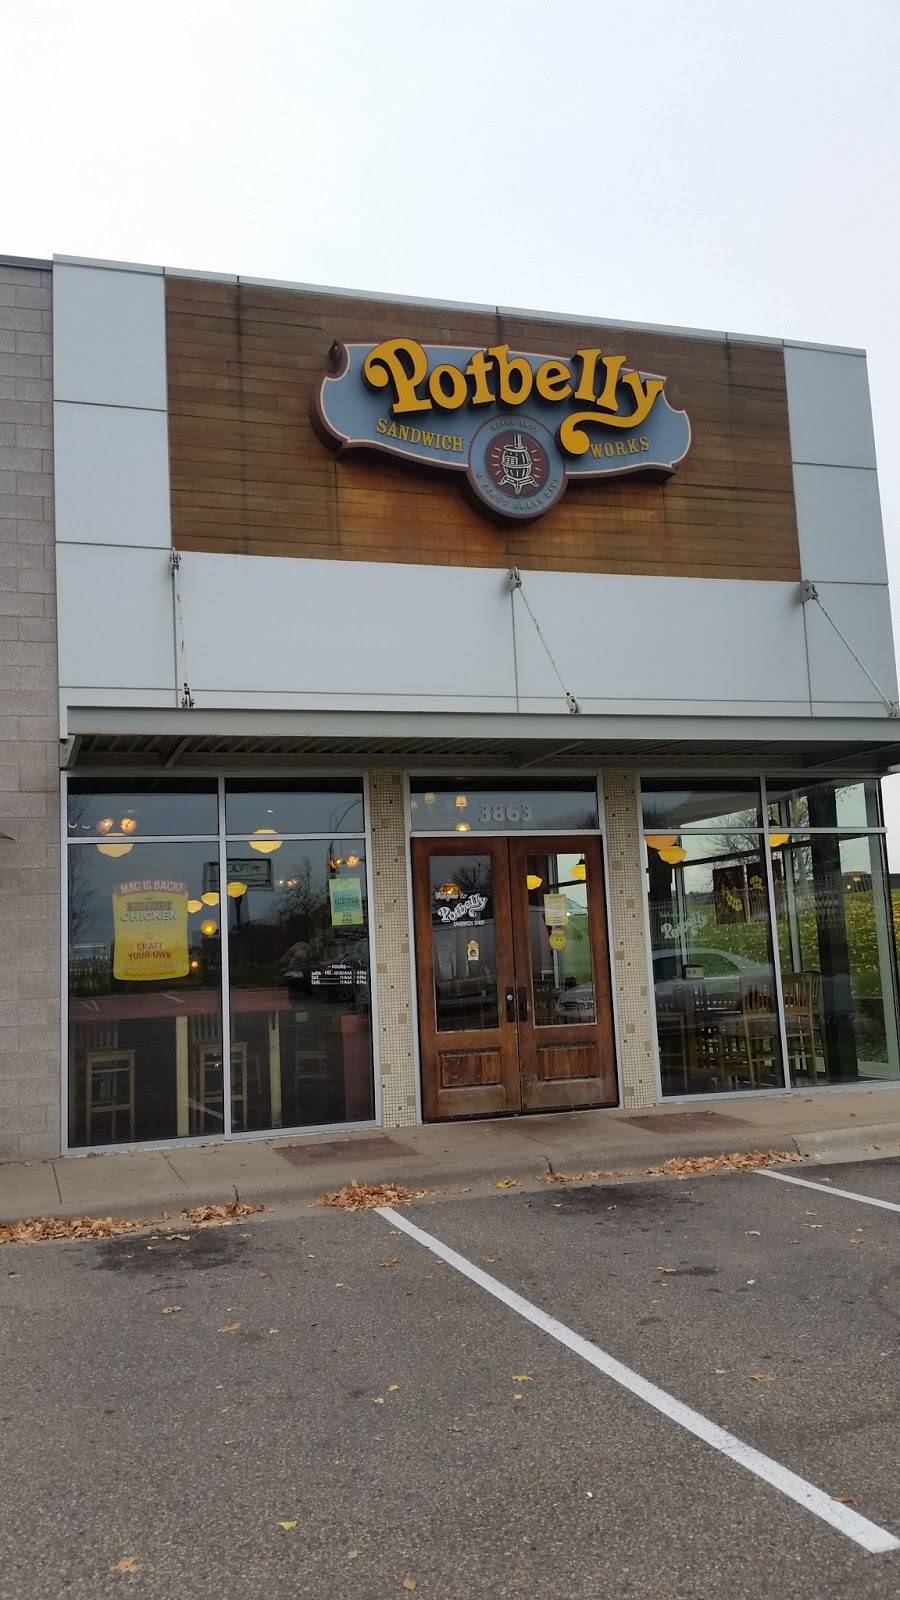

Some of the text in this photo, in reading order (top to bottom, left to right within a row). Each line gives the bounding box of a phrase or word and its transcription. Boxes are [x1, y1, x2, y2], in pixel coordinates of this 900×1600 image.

[363, 337, 665, 455] Potbelly
[376, 417, 649, 459] SANDWICH WORKS
[479, 804, 532, 823] 3863
[120, 881, 141, 894] MAC
[142, 880, 152, 890] IS
[121, 911, 178, 922] CHICKEN
[437, 893, 488, 923] Potbelly
[137, 942, 163, 951] CRAFT
